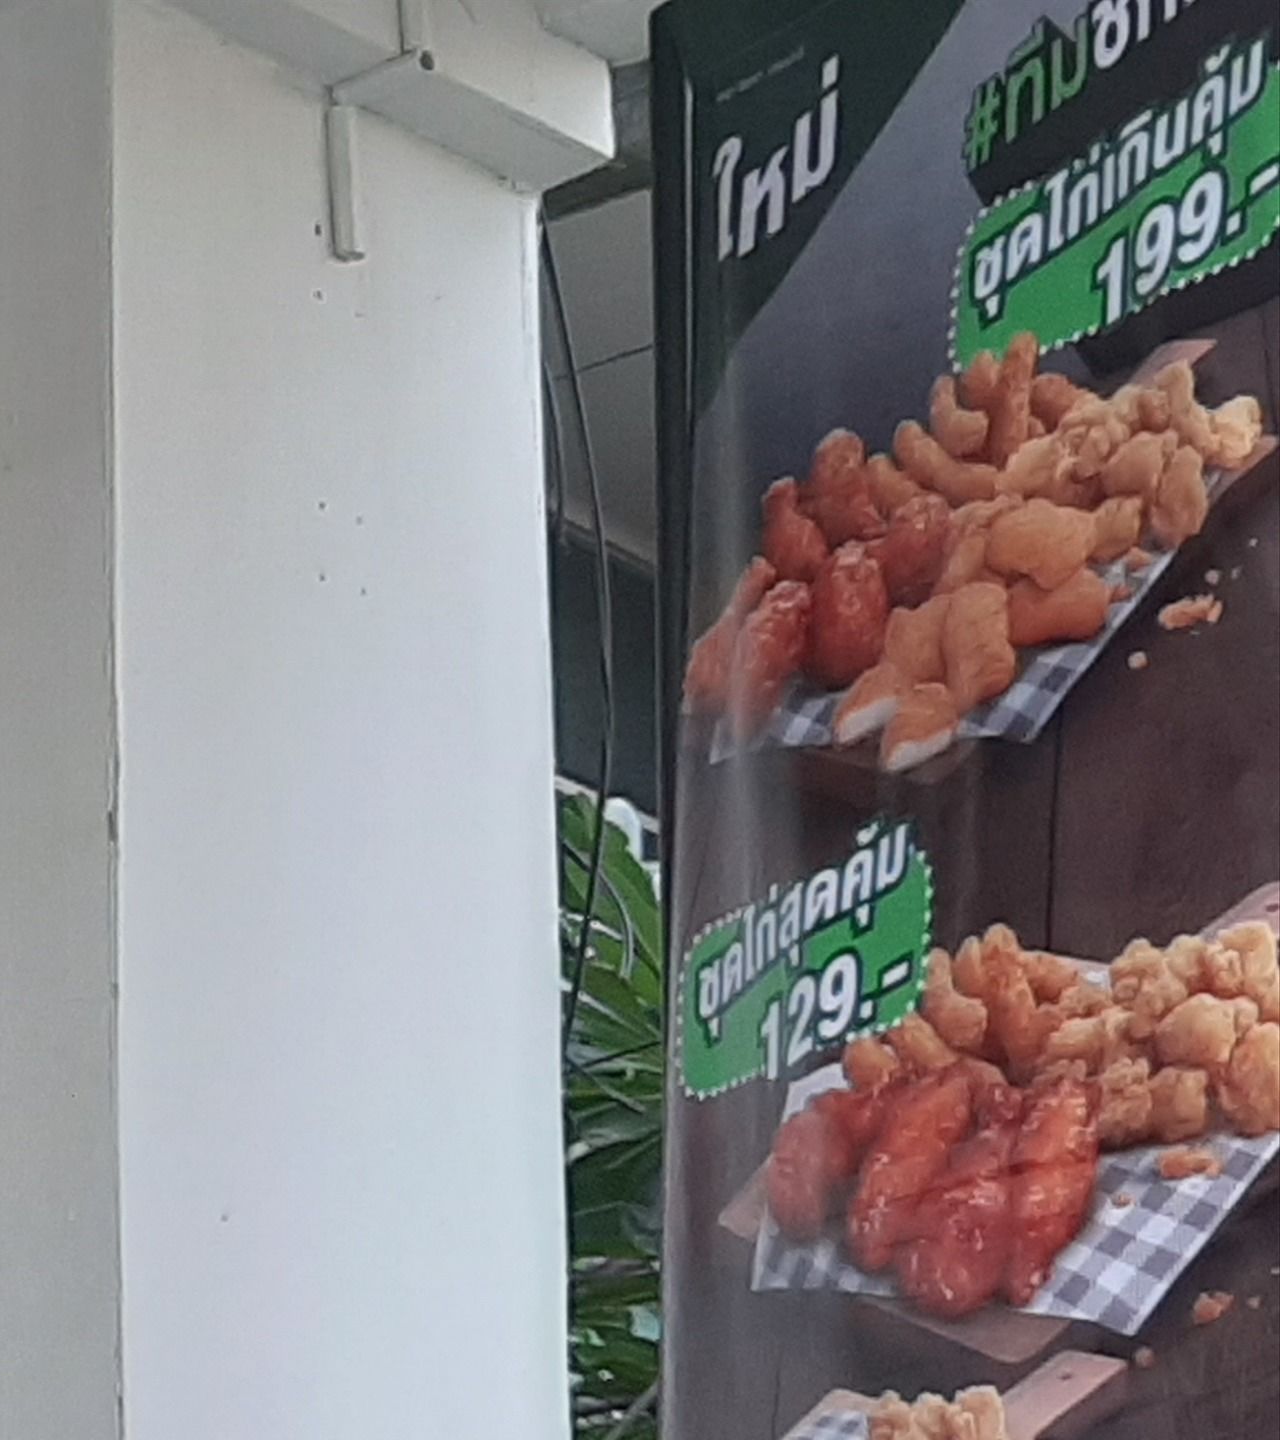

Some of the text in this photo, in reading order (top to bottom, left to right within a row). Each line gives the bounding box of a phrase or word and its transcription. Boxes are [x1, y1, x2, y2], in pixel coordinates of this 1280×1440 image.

[713, 54, 840, 262] ใหม่
[973, 39, 1265, 317] ชุดไก่เกินคุ้ม
[1097, 163, 1280, 325] 199.-
[697, 822, 910, 1037] ชุดไก่สุดคุ้ม
[759, 953, 911, 1081] 129.-
